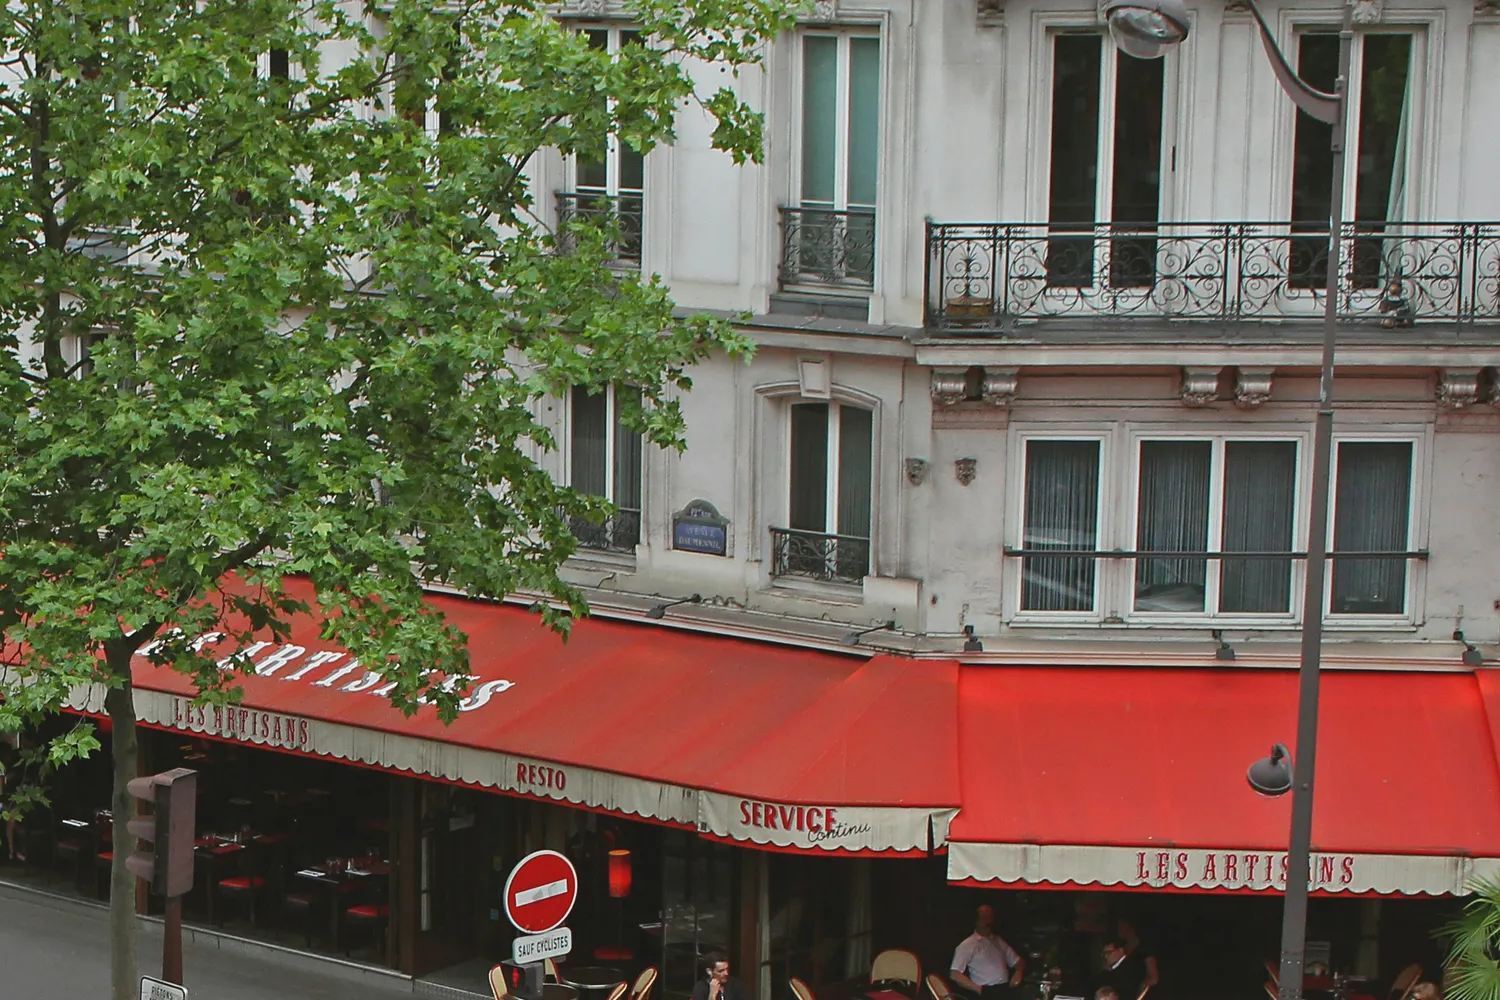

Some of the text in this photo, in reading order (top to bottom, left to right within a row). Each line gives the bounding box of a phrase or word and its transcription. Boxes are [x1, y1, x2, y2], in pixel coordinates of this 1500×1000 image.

[174, 698, 308, 744] LES ARTISANS
[516, 762, 567, 791] RESTO
[740, 800, 838, 833] SERVICE
[807, 822, 871, 843] Continu
[1135, 852, 1355, 885] LES ARTISNS
[518, 936, 569, 957] SAUF CYCLISTES
